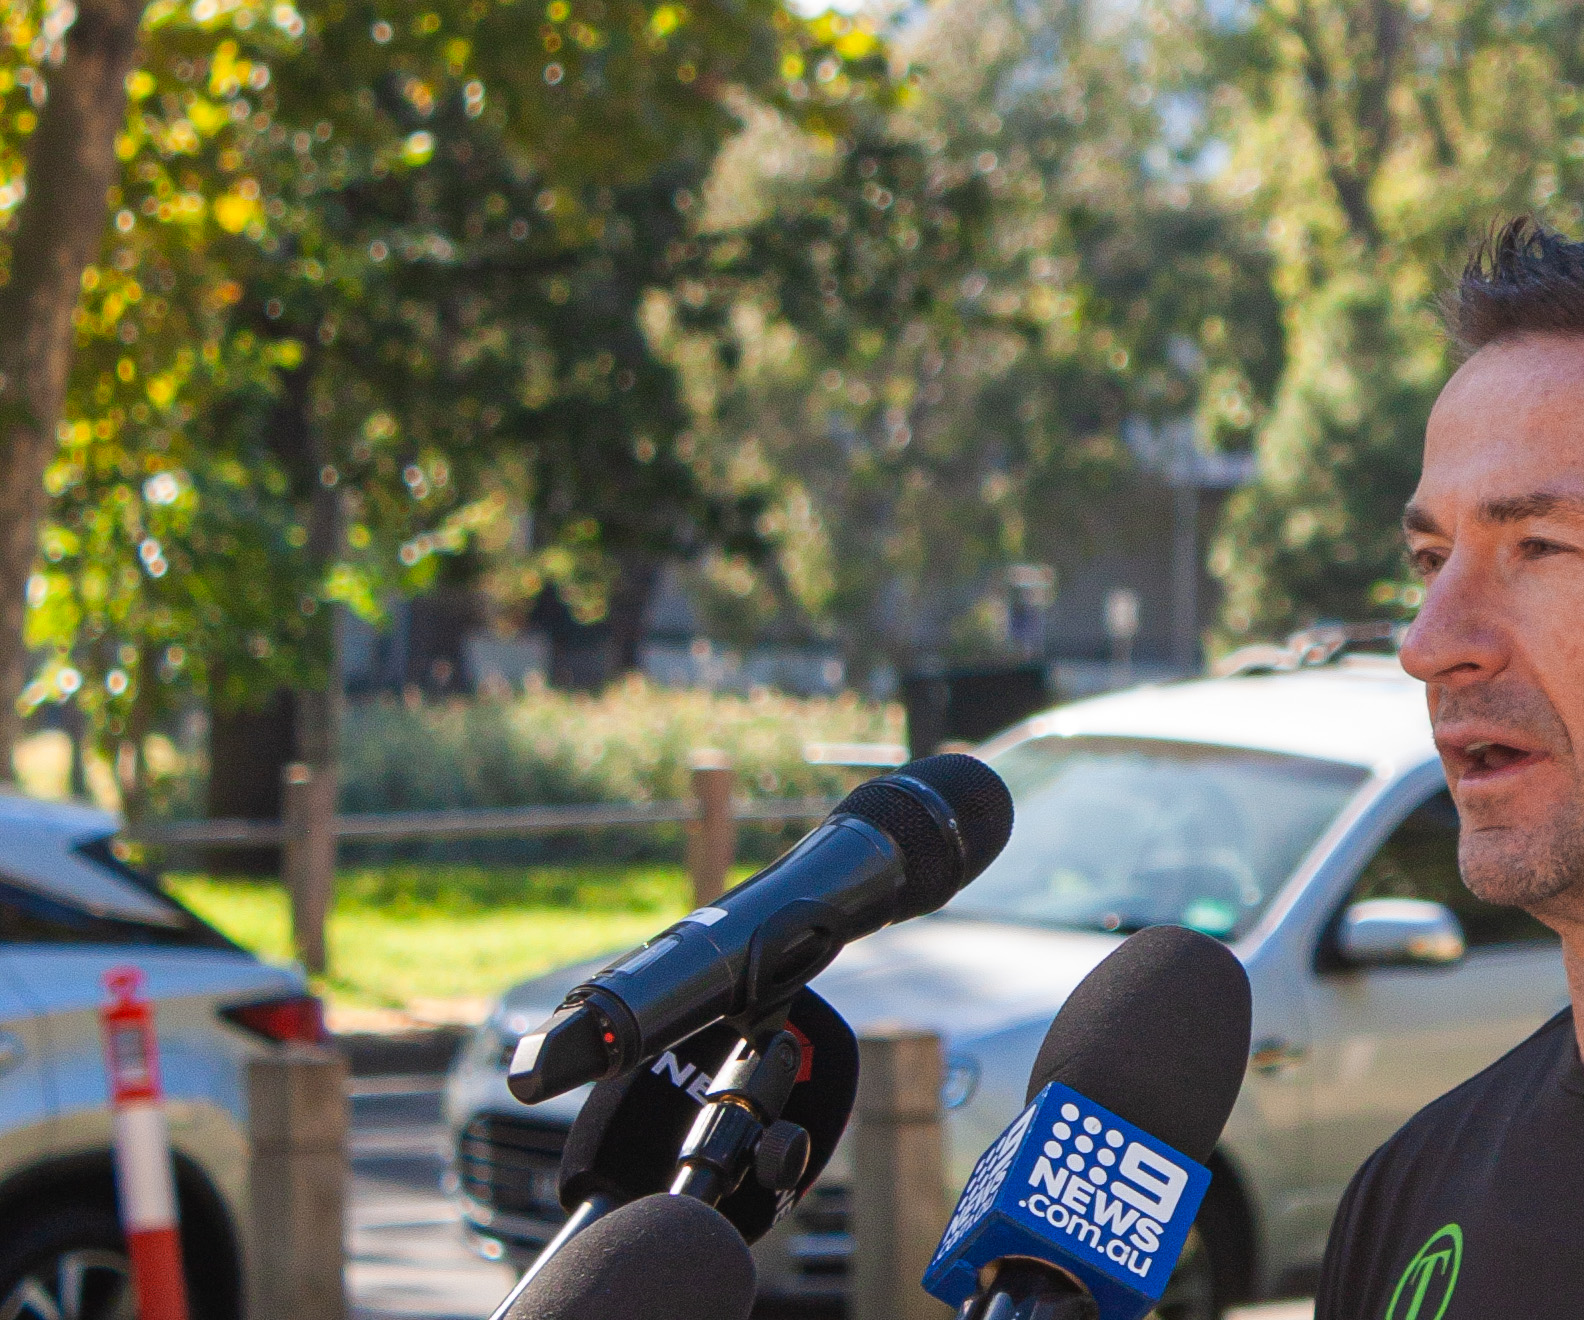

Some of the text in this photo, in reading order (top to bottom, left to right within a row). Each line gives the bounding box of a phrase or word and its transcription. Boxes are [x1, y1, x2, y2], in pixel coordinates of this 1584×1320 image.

[1028, 1155, 1160, 1254] NEWS
[1111, 1141, 1189, 1225] 9
[1018, 1193, 1152, 1278] .com.au
